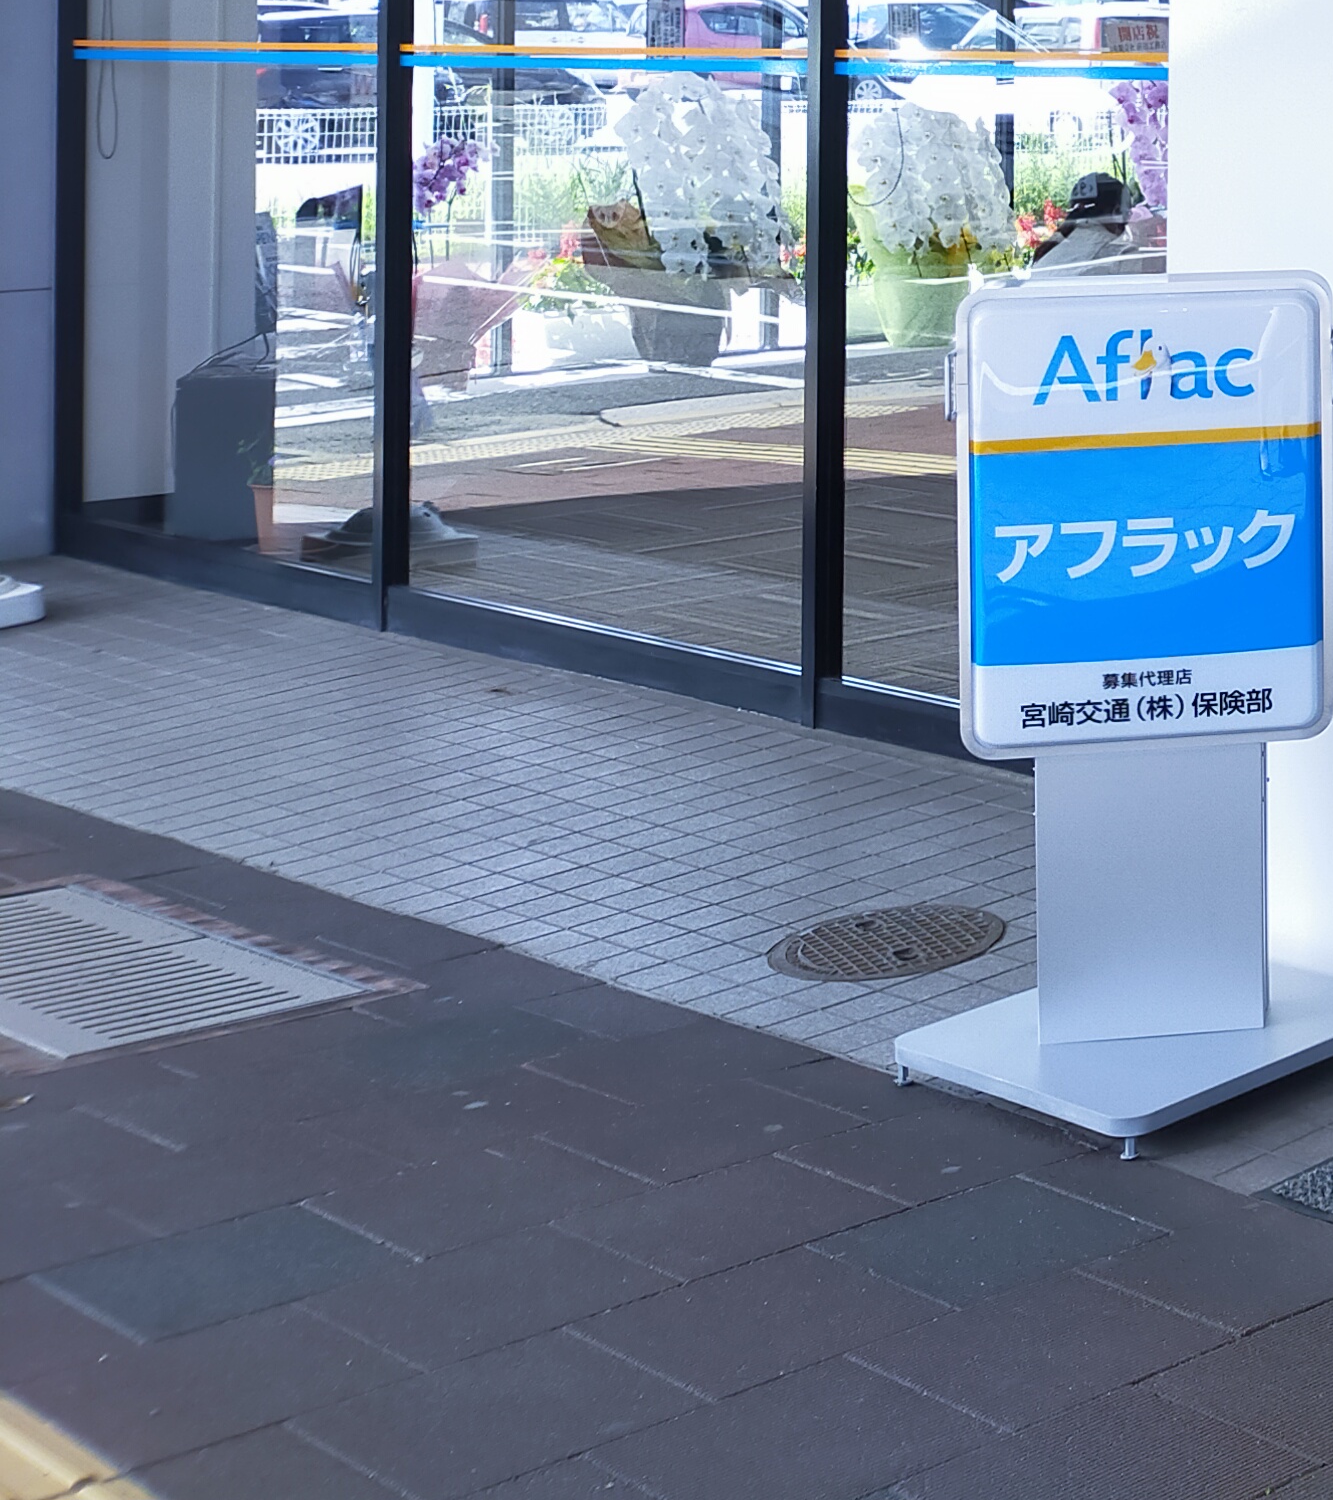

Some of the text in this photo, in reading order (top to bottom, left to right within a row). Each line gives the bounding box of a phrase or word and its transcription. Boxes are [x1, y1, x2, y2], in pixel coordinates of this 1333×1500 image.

[1032, 328, 1255, 406] Aflac
[994, 509, 1296, 584] アフラック
[1102, 668, 1193, 690] 募集代理店
